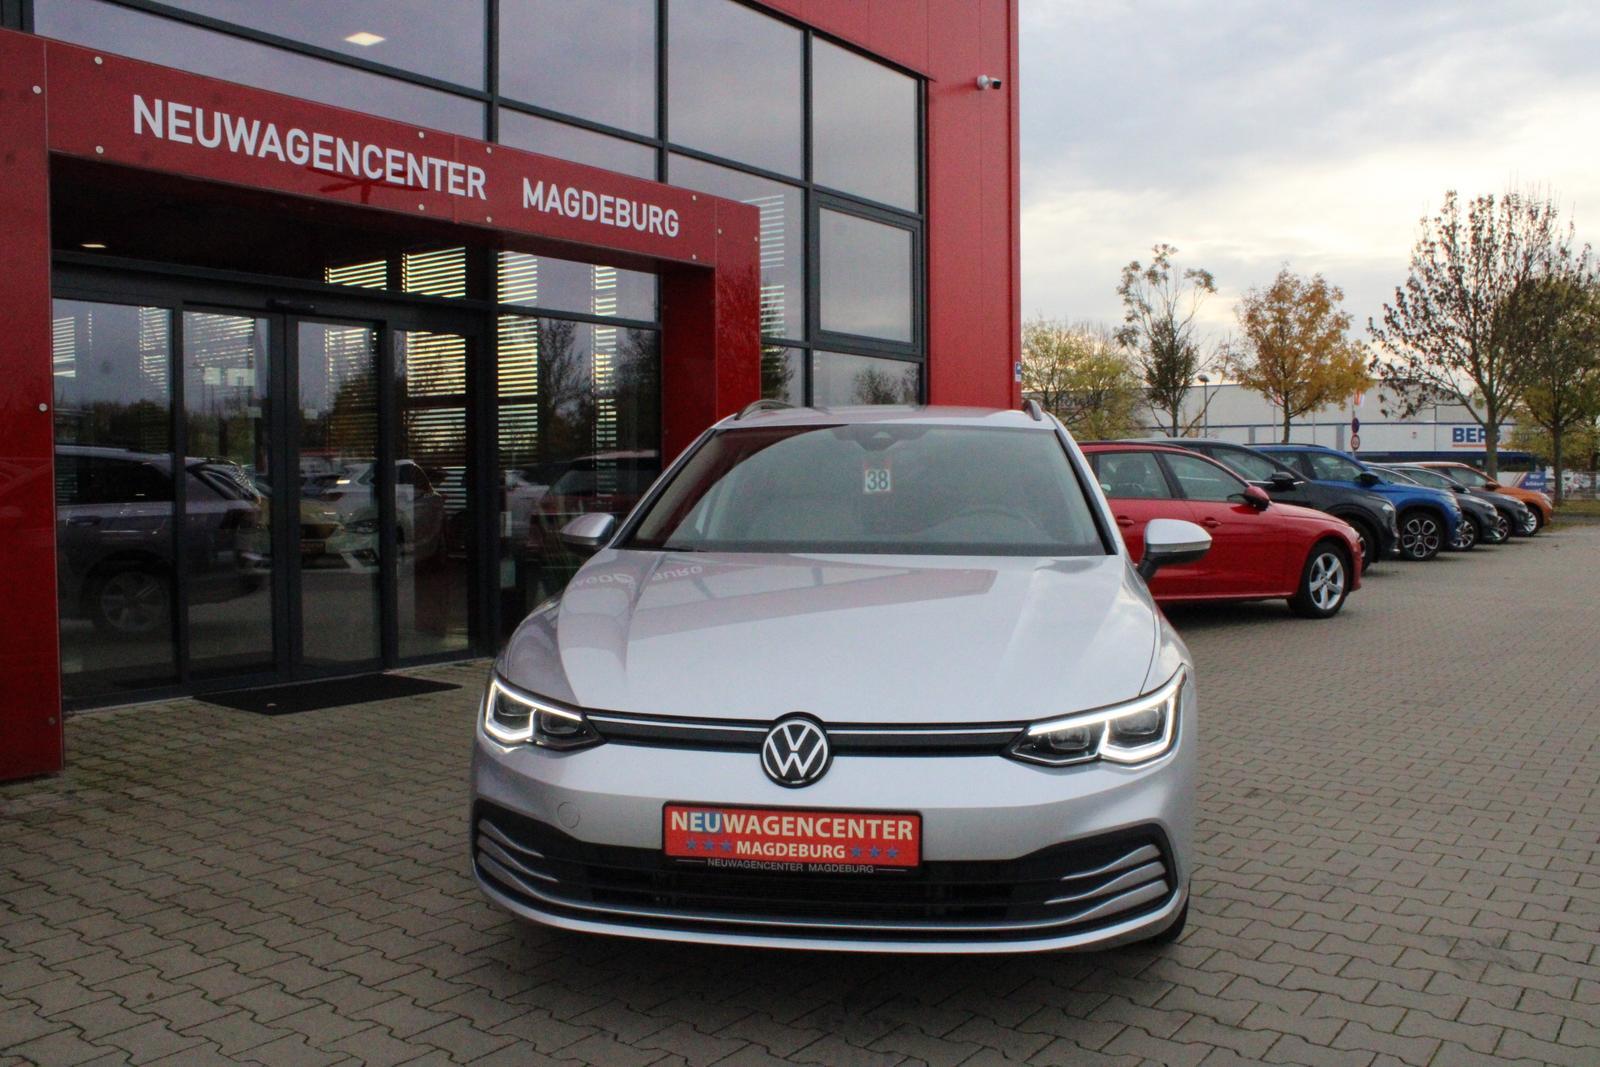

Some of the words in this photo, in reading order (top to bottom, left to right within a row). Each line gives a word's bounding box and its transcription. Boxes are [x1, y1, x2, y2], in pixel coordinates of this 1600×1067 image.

[133, 94, 487, 201] NEUWAGENCENTER
[522, 177, 680, 238] MAGDEBURG
[867, 470, 889, 490] 38
[671, 811, 913, 841] NEUWAGENCENTER
[736, 840, 846, 859] MAGDEBURG
[707, 858, 804, 873] NEUWAGENCENTER
[808, 863, 875, 874] MAGDEBURG
